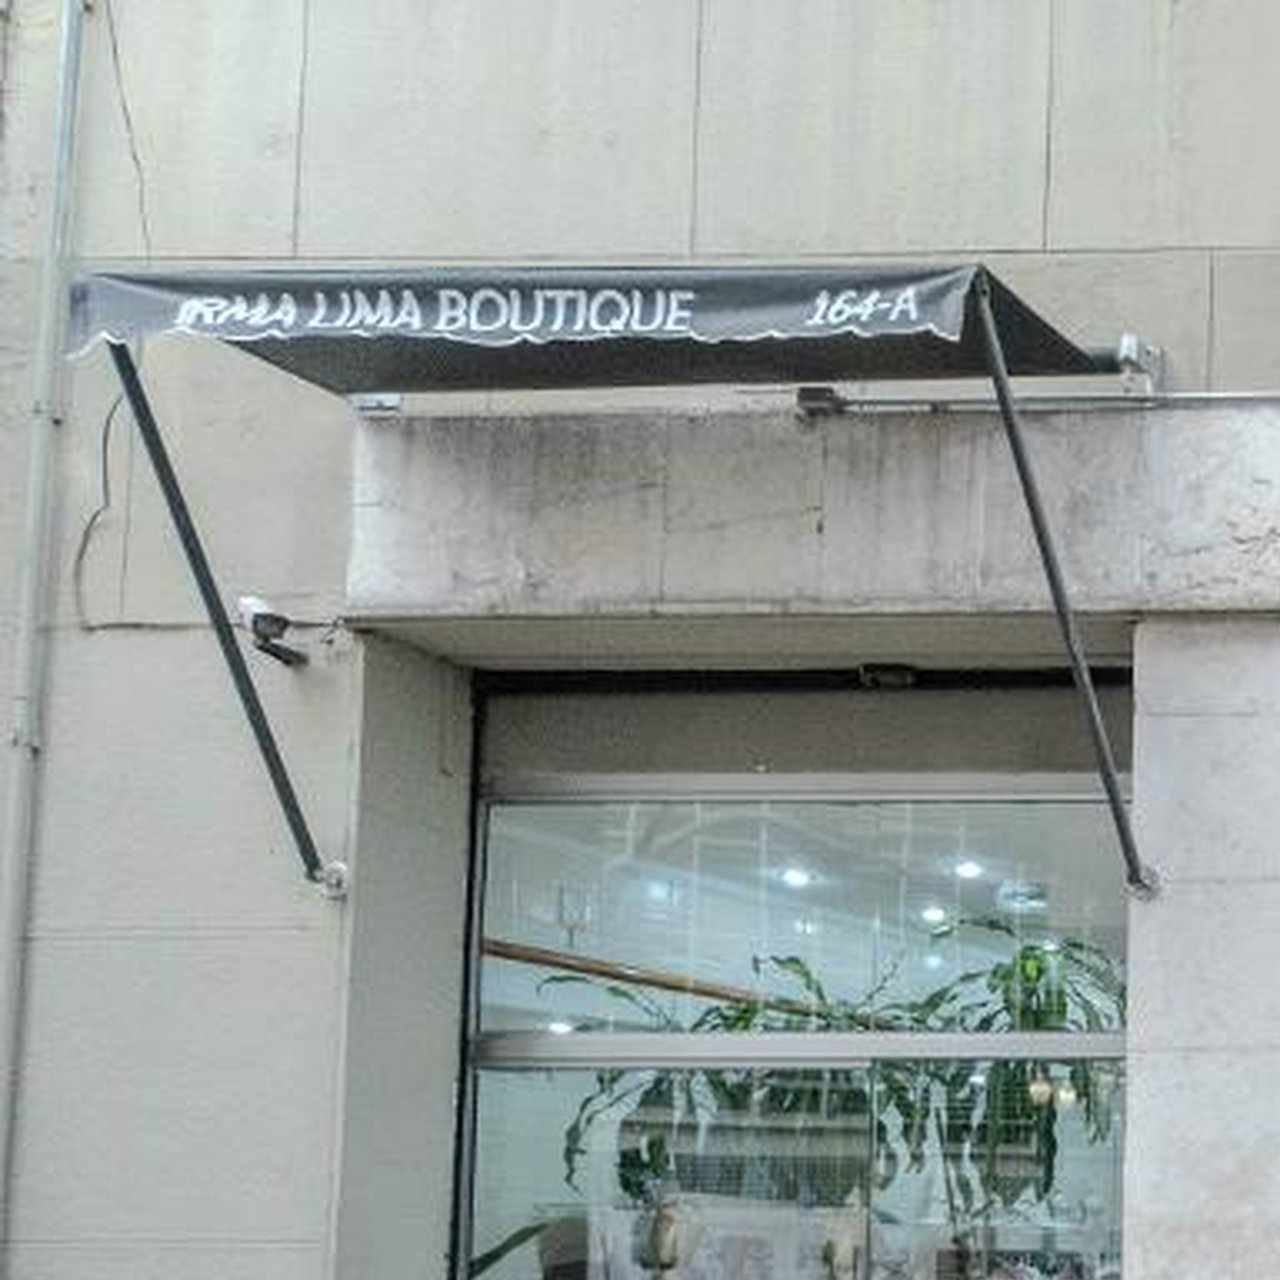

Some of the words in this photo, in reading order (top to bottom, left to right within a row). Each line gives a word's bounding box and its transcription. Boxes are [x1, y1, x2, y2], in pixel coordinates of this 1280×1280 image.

[308, 289, 423, 330] LIMA
[433, 287, 696, 332] BOUTIQUE
[804, 285, 919, 325] 164-A
